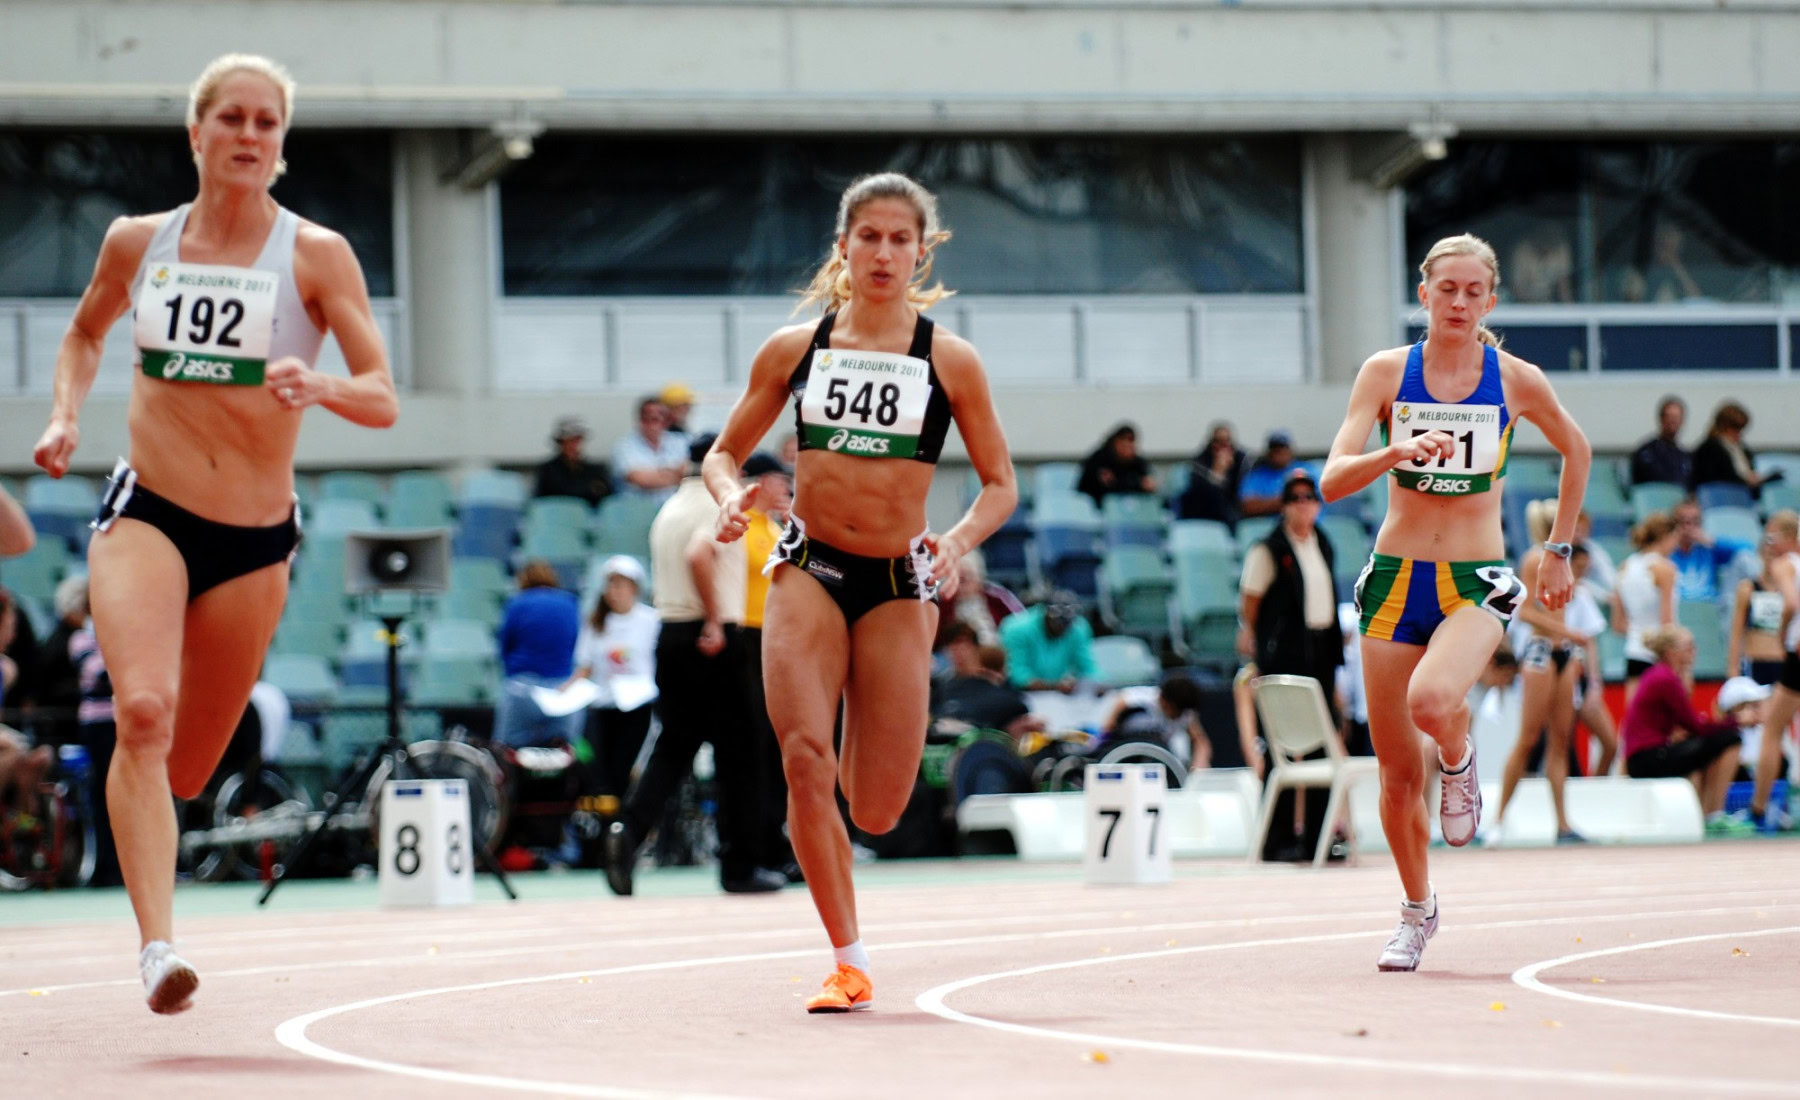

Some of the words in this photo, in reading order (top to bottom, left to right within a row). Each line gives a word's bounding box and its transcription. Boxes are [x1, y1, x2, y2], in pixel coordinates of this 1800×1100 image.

[177, 273, 240, 289] MELBOURNE
[244, 279, 272, 293] 2011
[165, 293, 245, 348] 192
[840, 358, 898, 373] MELBOURNE
[900, 364, 923, 378] 2011
[824, 377, 900, 427] 548
[1417, 411, 1473, 422] MELBOURNE
[1475, 413, 1495, 423] 2011
[846, 434, 890, 453] asics
[1432, 479, 1472, 492] asics
[395, 824, 421, 876] 8
[446, 823, 463, 876] 8
[1098, 809, 1122, 858] 7
[1145, 807, 1160, 857] 7
